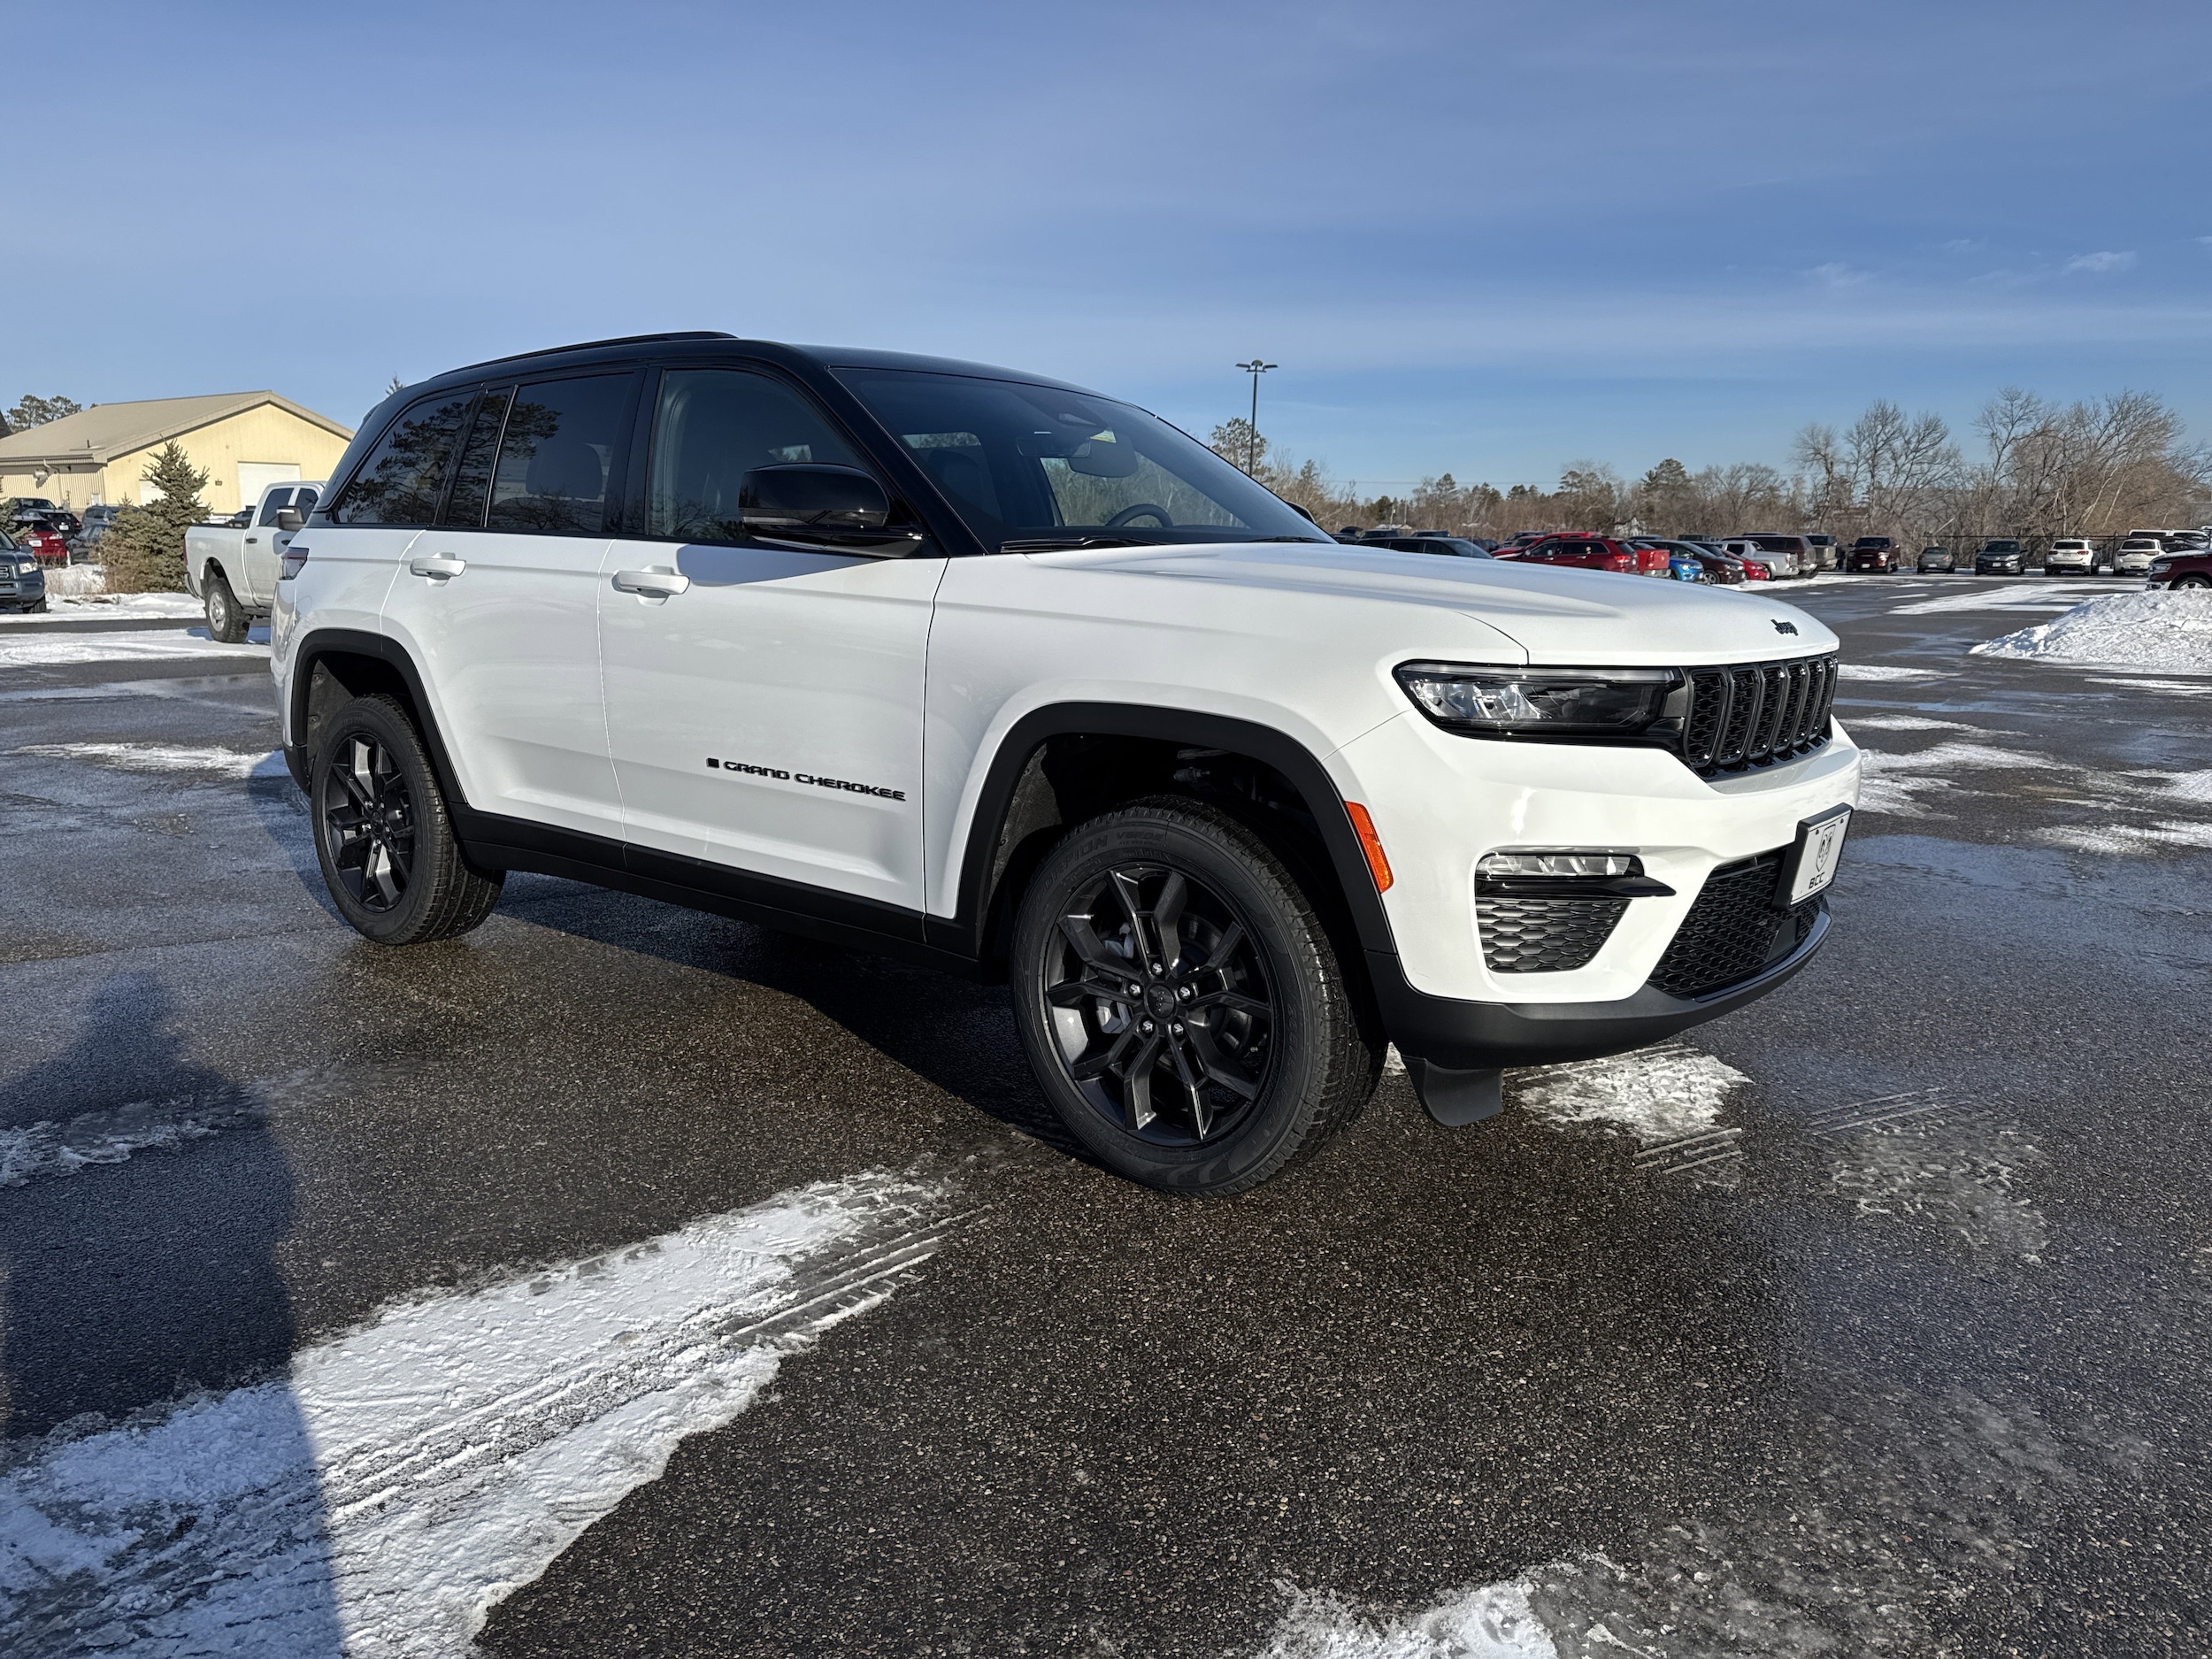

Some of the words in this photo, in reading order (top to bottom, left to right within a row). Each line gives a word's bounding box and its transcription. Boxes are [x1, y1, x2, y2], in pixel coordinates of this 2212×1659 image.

[723, 761, 790, 780] GRAND
[794, 773, 907, 802] CHEROKEE
[1809, 872, 1825, 889] BCC
